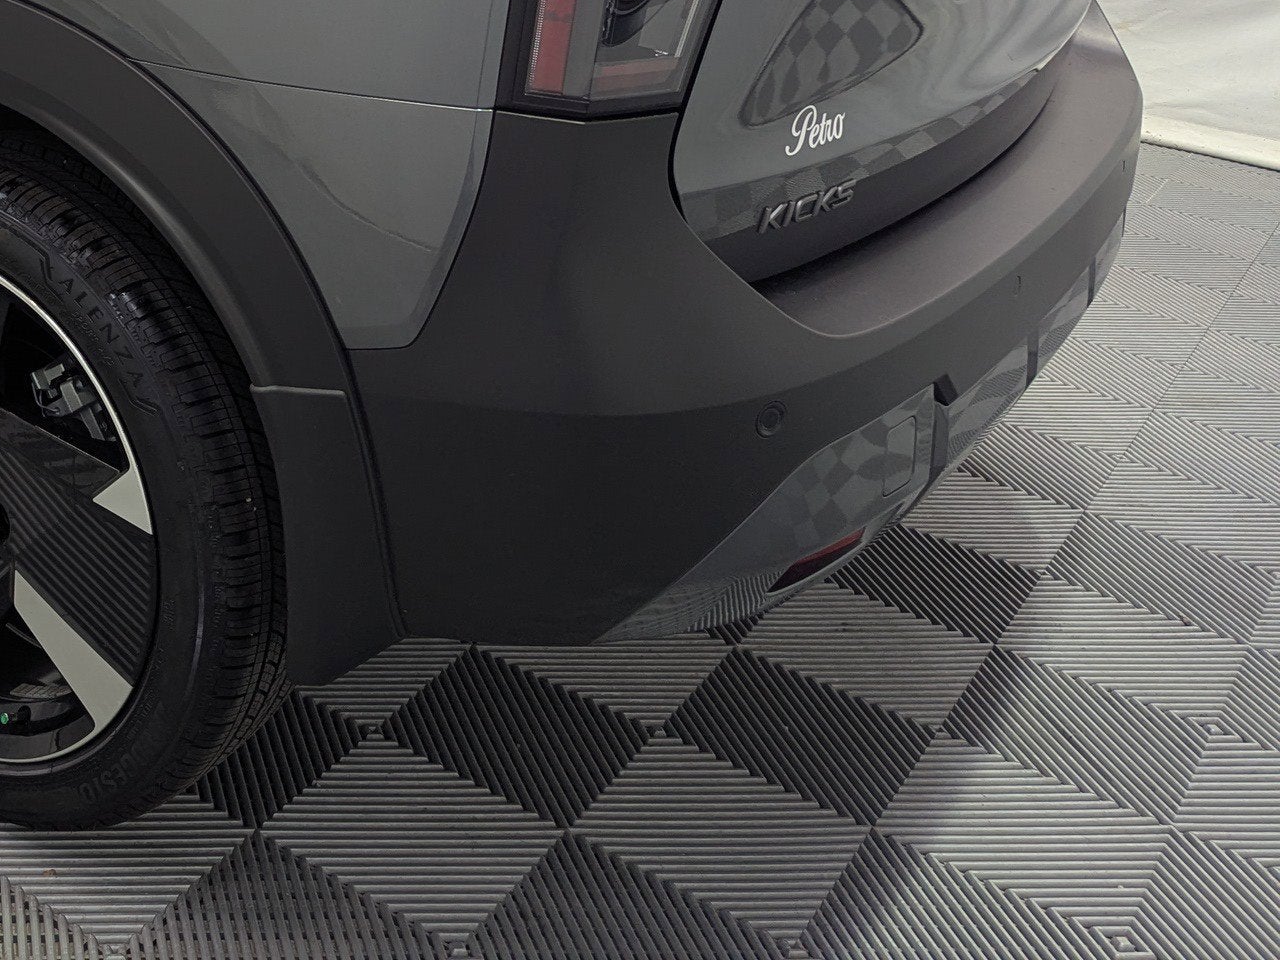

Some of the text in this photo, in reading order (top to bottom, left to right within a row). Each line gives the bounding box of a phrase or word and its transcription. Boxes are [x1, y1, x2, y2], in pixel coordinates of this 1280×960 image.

[785, 105, 845, 156] Petro
[758, 178, 857, 234] KICKS
[58, 278, 144, 389] ALENZA
